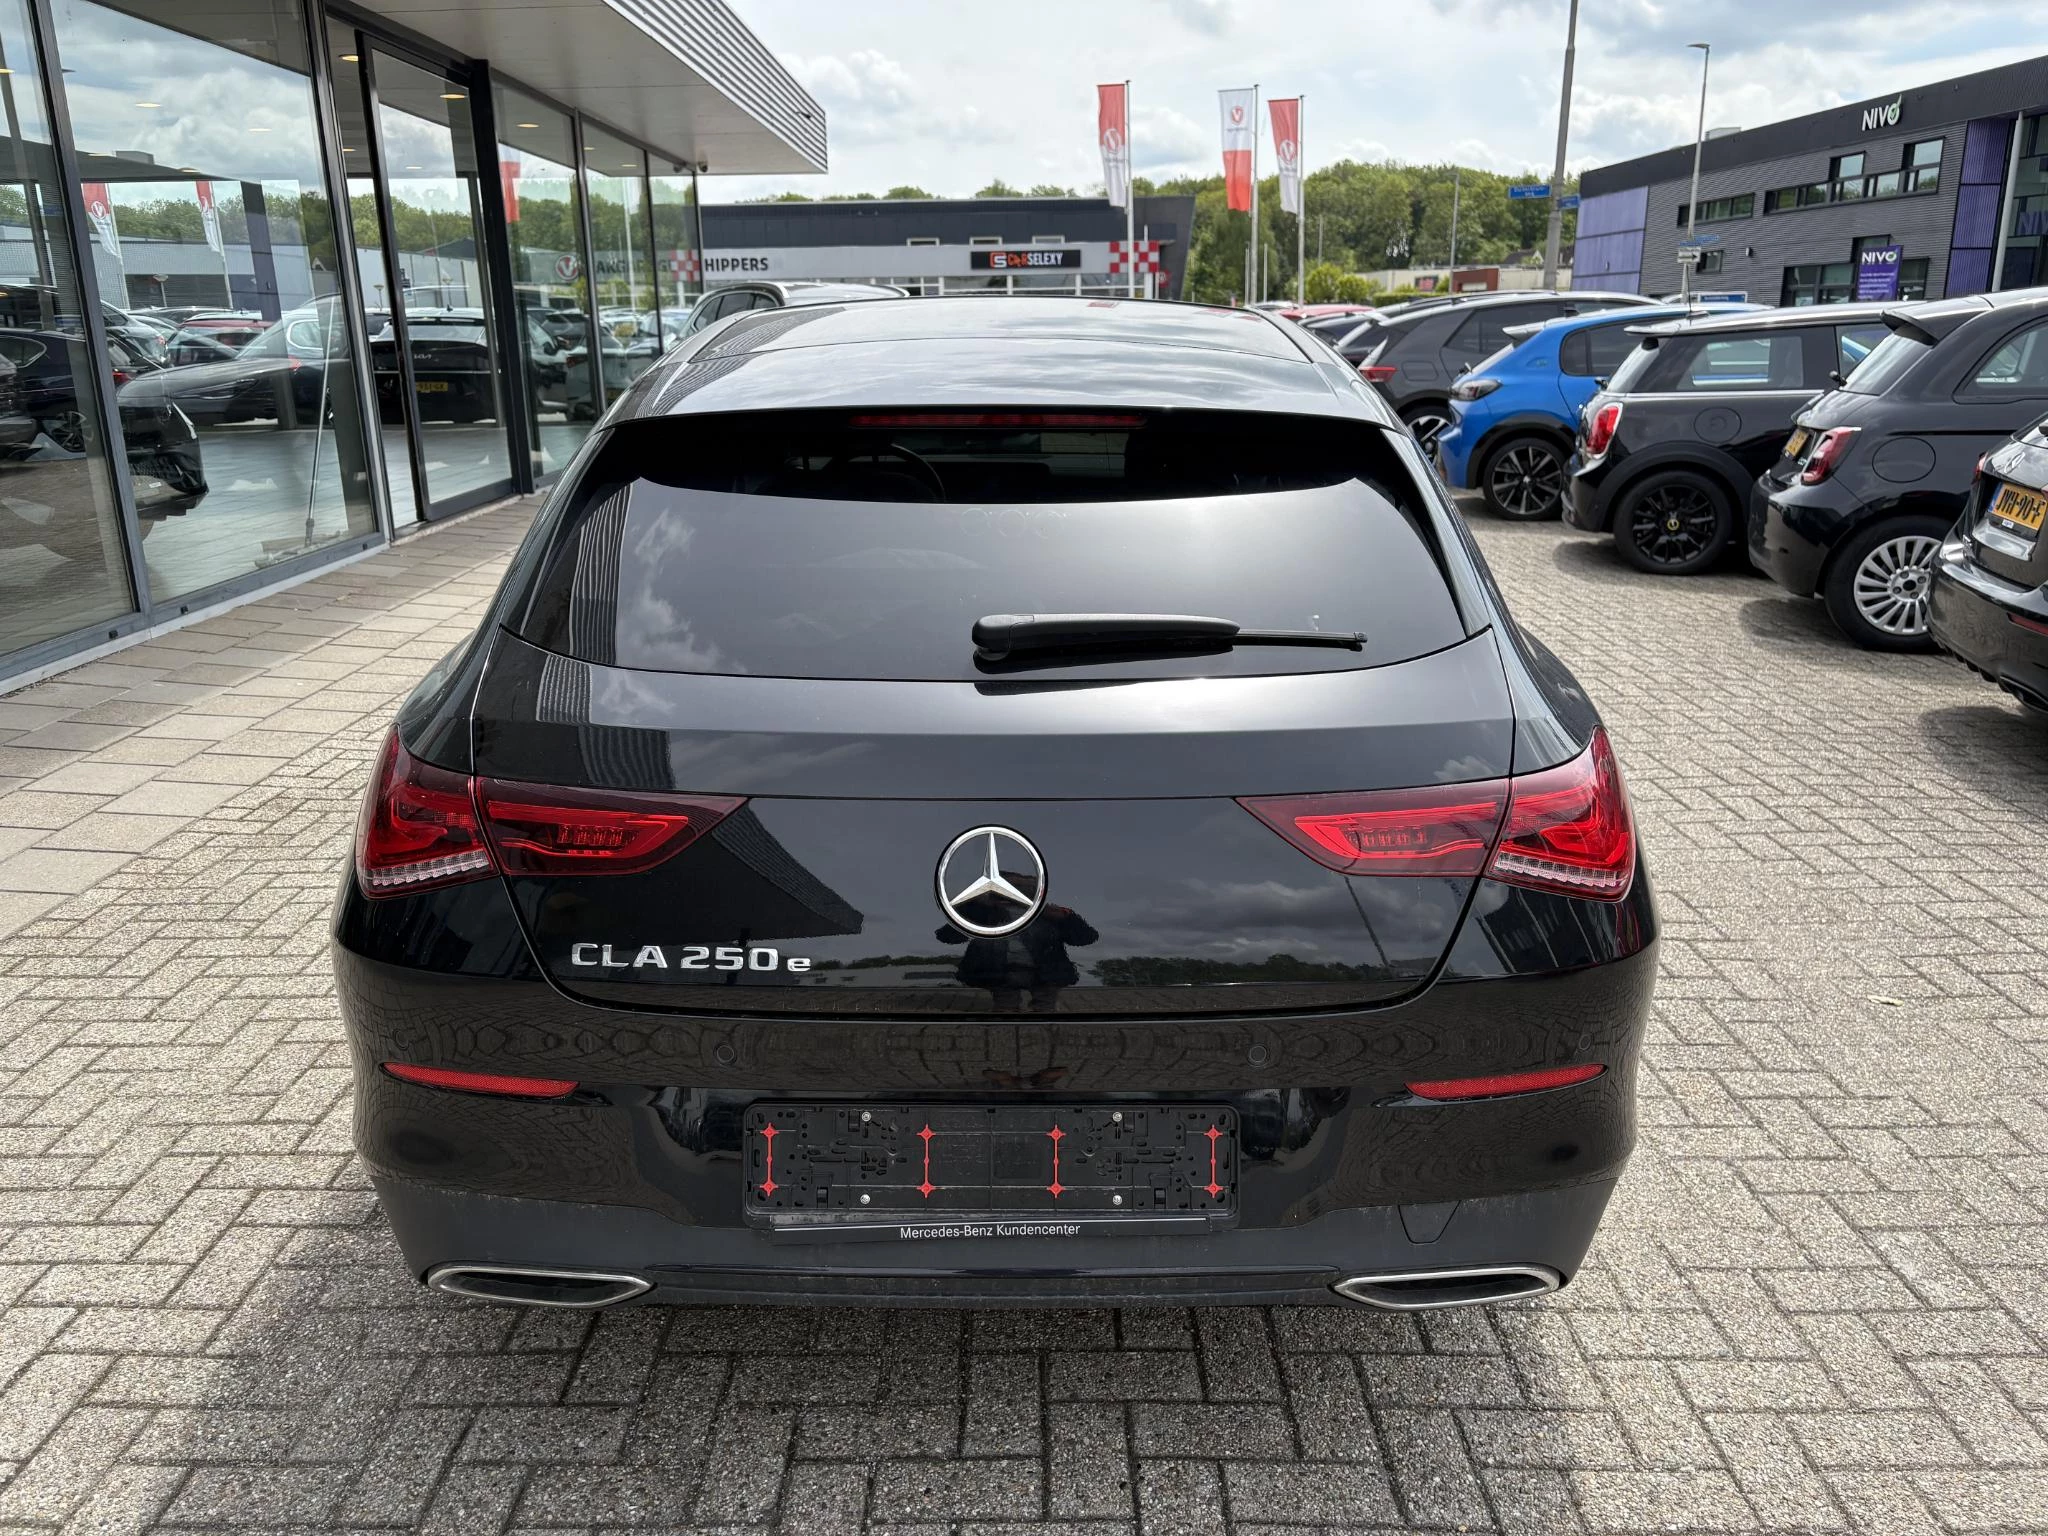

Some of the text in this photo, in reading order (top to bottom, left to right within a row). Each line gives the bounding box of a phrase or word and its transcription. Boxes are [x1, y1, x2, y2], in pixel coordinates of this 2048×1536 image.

[1861, 94, 1902, 131] NIVO
[704, 257, 769, 273] HIPPERS
[1861, 251, 1897, 265] NIVO
[571, 942, 668, 969] CLA
[899, 1223, 1081, 1239] Mercedes-Benz Kundencenter
